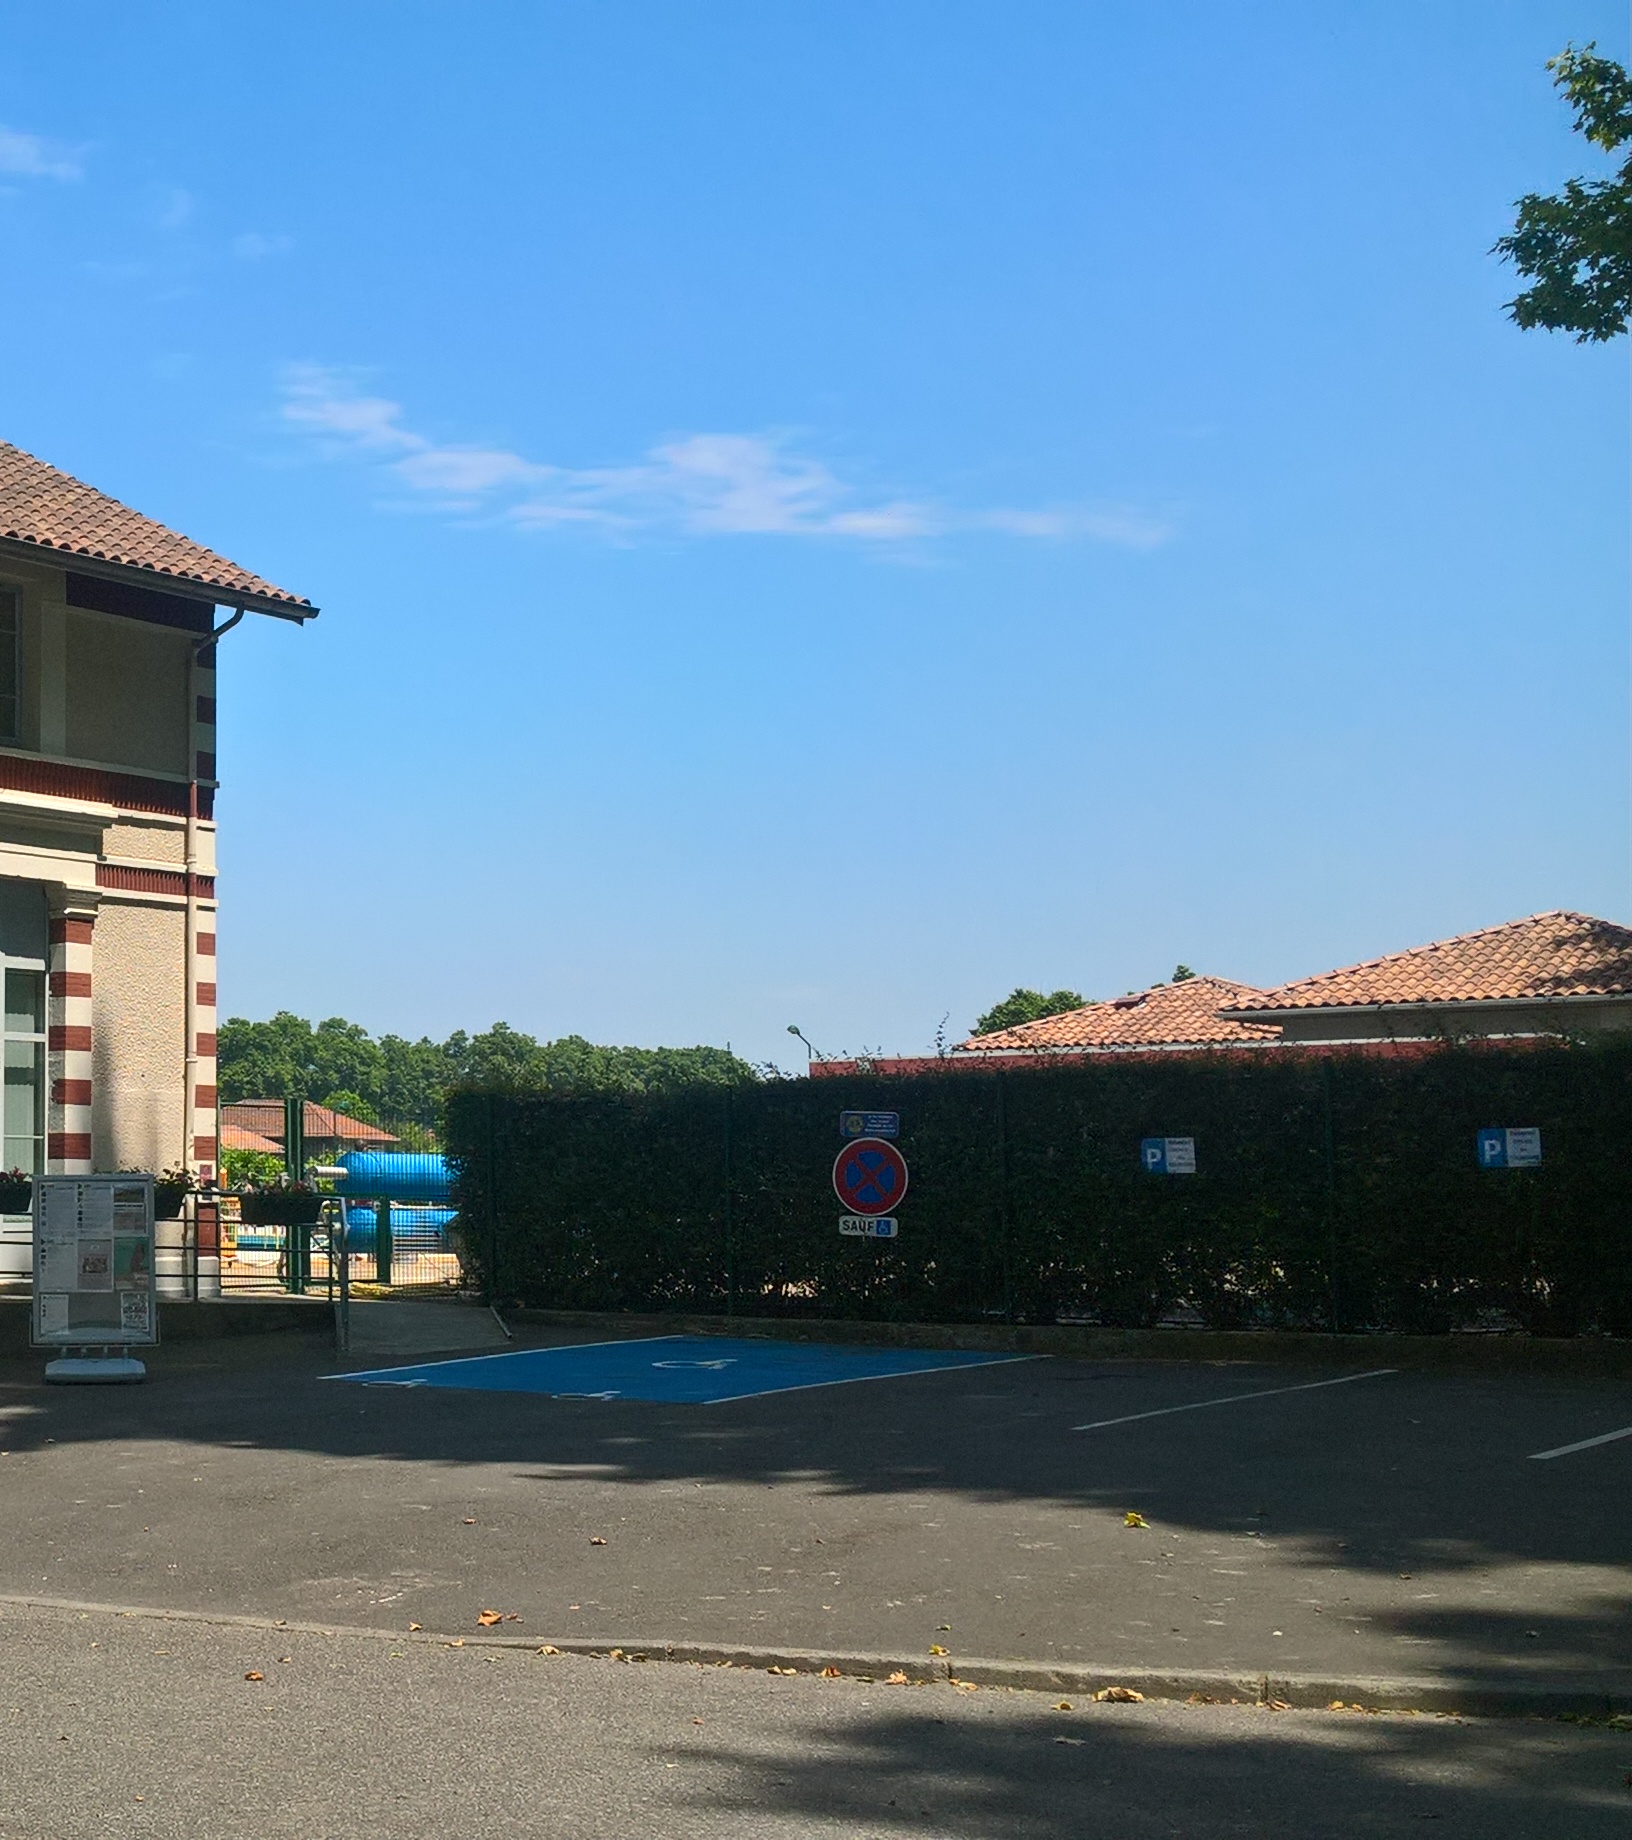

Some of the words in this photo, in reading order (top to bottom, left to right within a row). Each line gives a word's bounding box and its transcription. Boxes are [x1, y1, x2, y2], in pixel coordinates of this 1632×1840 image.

[1146, 1148, 1162, 1170] P
[1483, 1139, 1501, 1163] P
[842, 1218, 874, 1233] SAUF
